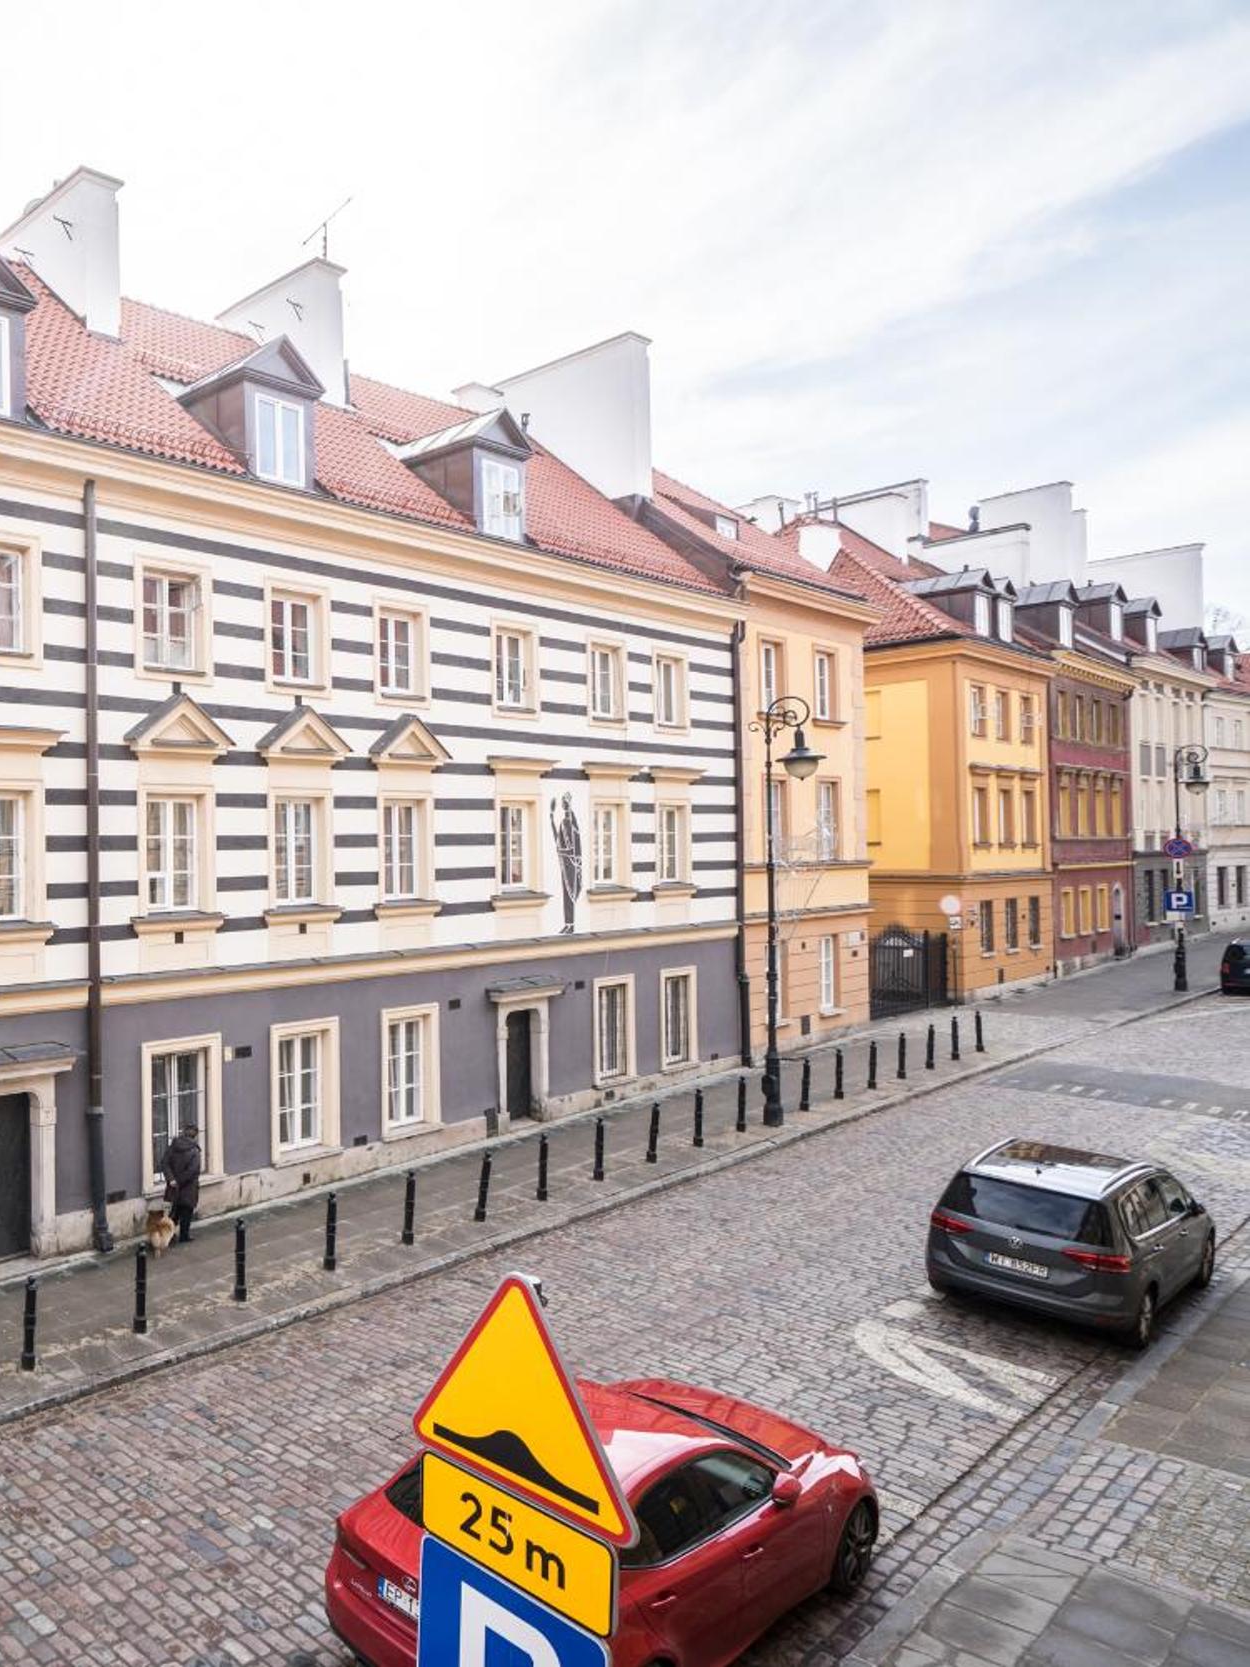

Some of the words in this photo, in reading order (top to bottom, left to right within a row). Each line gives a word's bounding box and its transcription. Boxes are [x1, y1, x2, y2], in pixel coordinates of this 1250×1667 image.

[1171, 892, 1188, 909] P
[459, 1492, 514, 1555] 25
[526, 1538, 565, 1590] m
[459, 1580, 561, 1667] P
